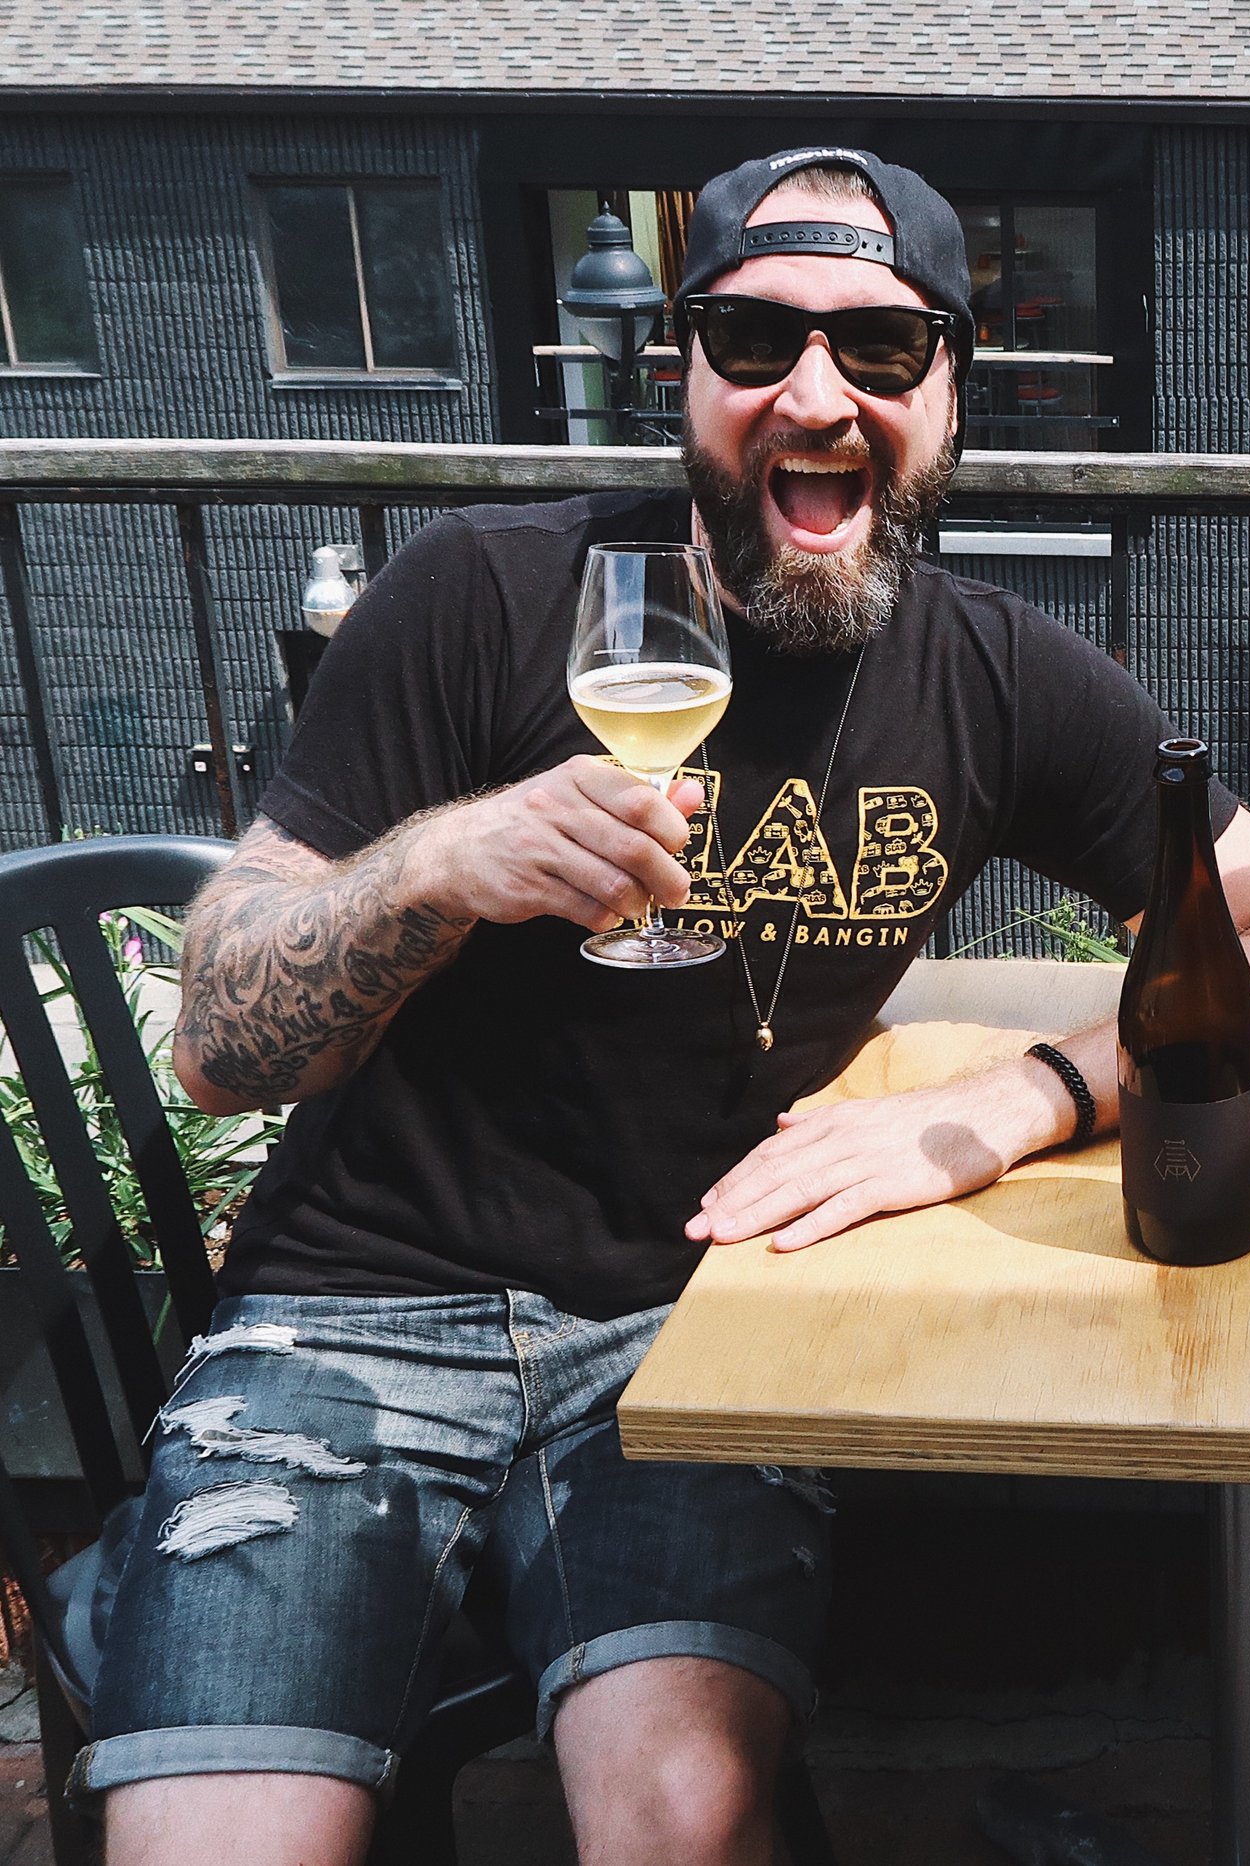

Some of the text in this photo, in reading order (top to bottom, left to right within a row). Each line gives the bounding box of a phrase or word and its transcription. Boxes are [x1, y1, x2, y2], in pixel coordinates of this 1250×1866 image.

[593, 754, 949, 920] LAB
[760, 923, 777, 942] &
[794, 925, 909, 948] BANGIN
